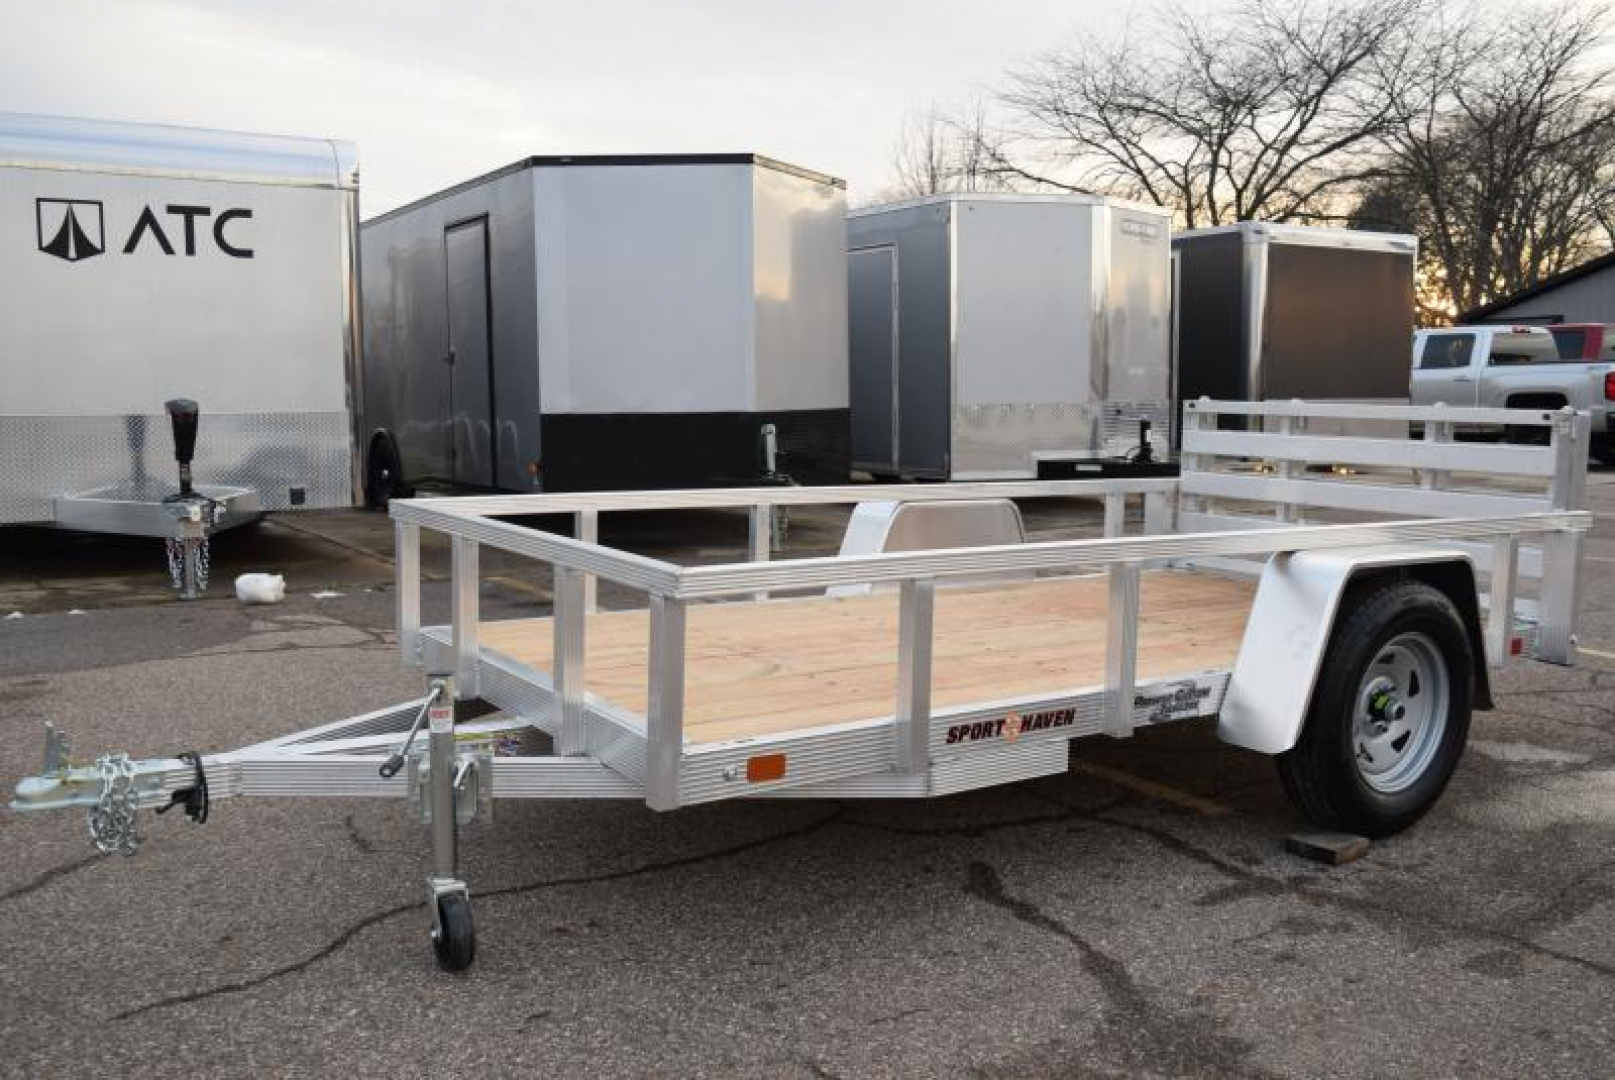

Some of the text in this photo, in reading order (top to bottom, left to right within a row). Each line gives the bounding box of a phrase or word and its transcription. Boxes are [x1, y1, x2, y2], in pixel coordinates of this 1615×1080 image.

[122, 204, 254, 259] ATC
[946, 707, 1076, 744] SPORT HAVEN
